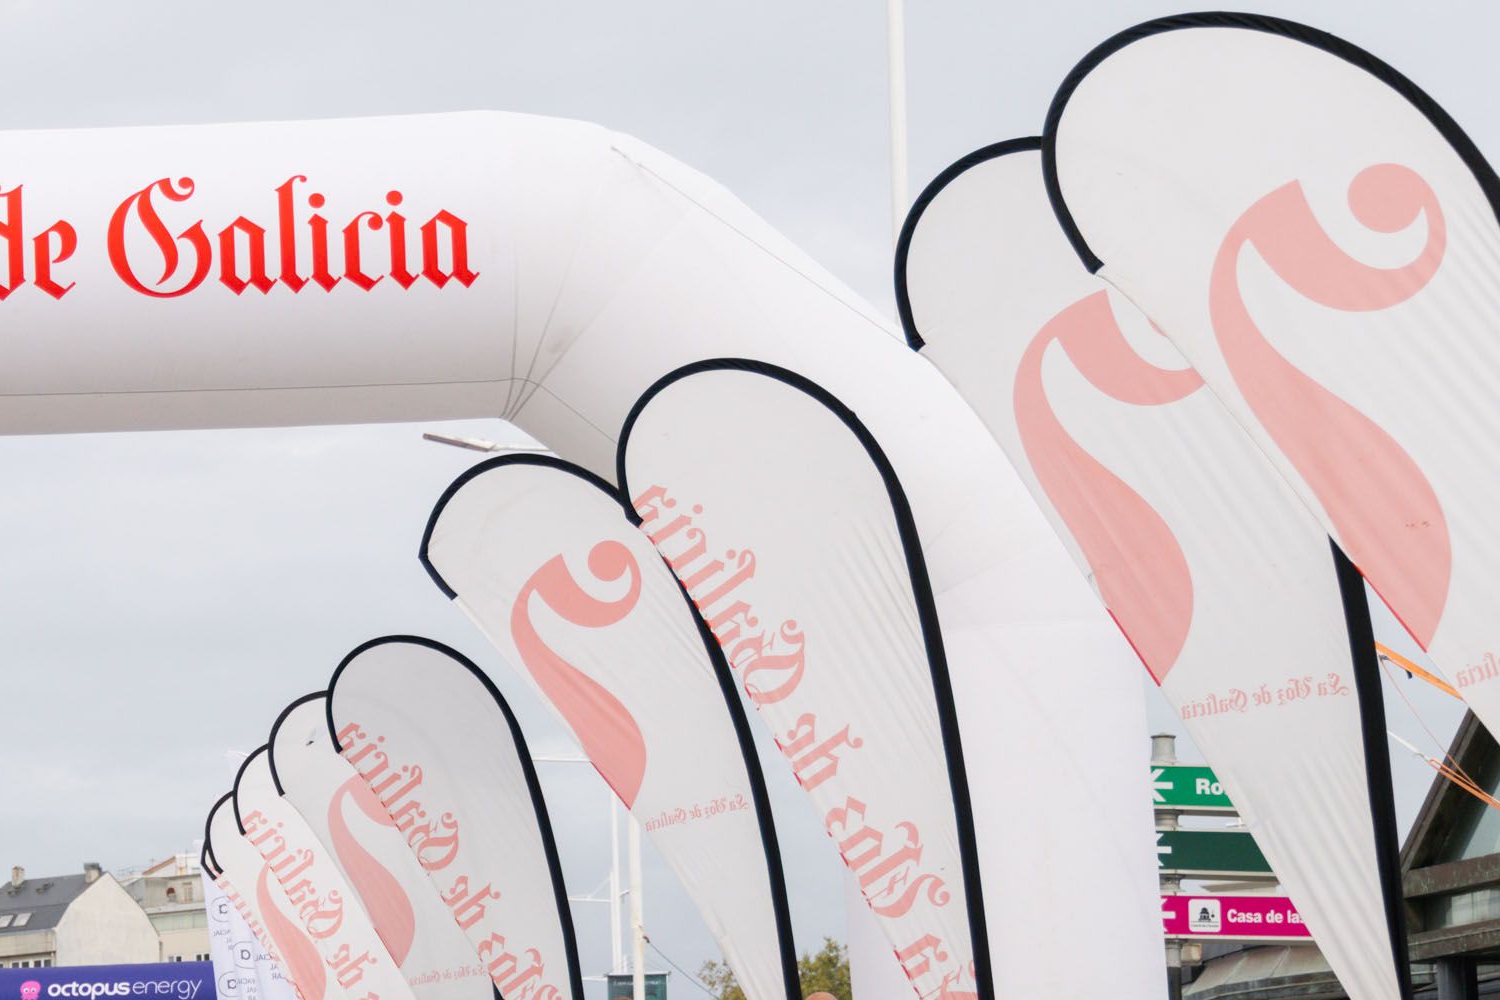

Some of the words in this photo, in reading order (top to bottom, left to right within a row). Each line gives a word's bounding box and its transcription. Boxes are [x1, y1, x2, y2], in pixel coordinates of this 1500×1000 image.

[107, 175, 481, 299] Galicia
[1227, 909, 1263, 924] Casa
[1266, 909, 1284, 924] de
[47, 980, 130, 1000] octopus
[132, 979, 202, 1000] energy
